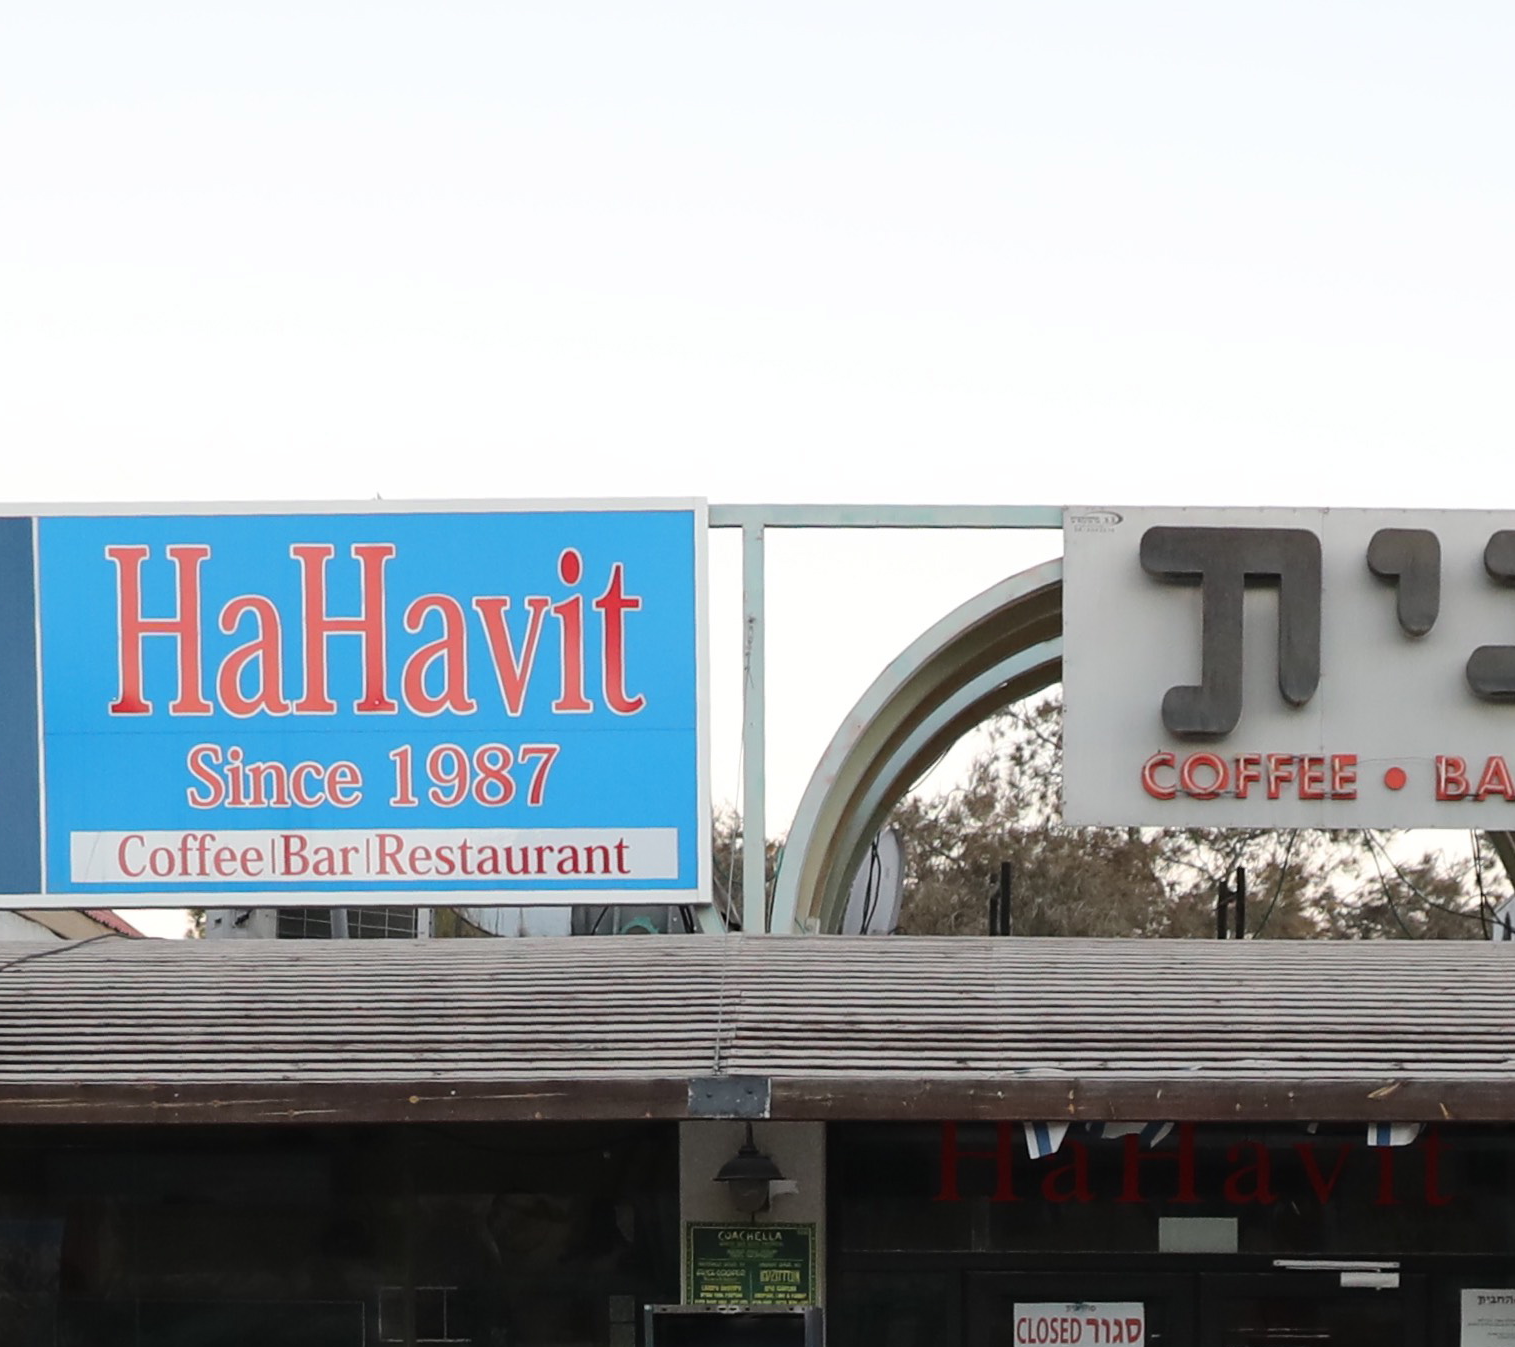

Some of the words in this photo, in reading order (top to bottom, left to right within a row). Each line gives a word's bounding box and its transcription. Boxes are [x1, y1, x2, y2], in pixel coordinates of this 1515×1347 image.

[104, 541, 645, 718] HaHavit
[186, 743, 361, 810] Since
[388, 744, 561, 808] 1987
[1140, 751, 1358, 801] COFFEE
[117, 834, 264, 877] Coffee
[280, 835, 361, 876] Bar
[378, 834, 631, 876] Restaurant
[1016, 1317, 1083, 1345] CLOSED
[1086, 1318, 1143, 1344] סגור
